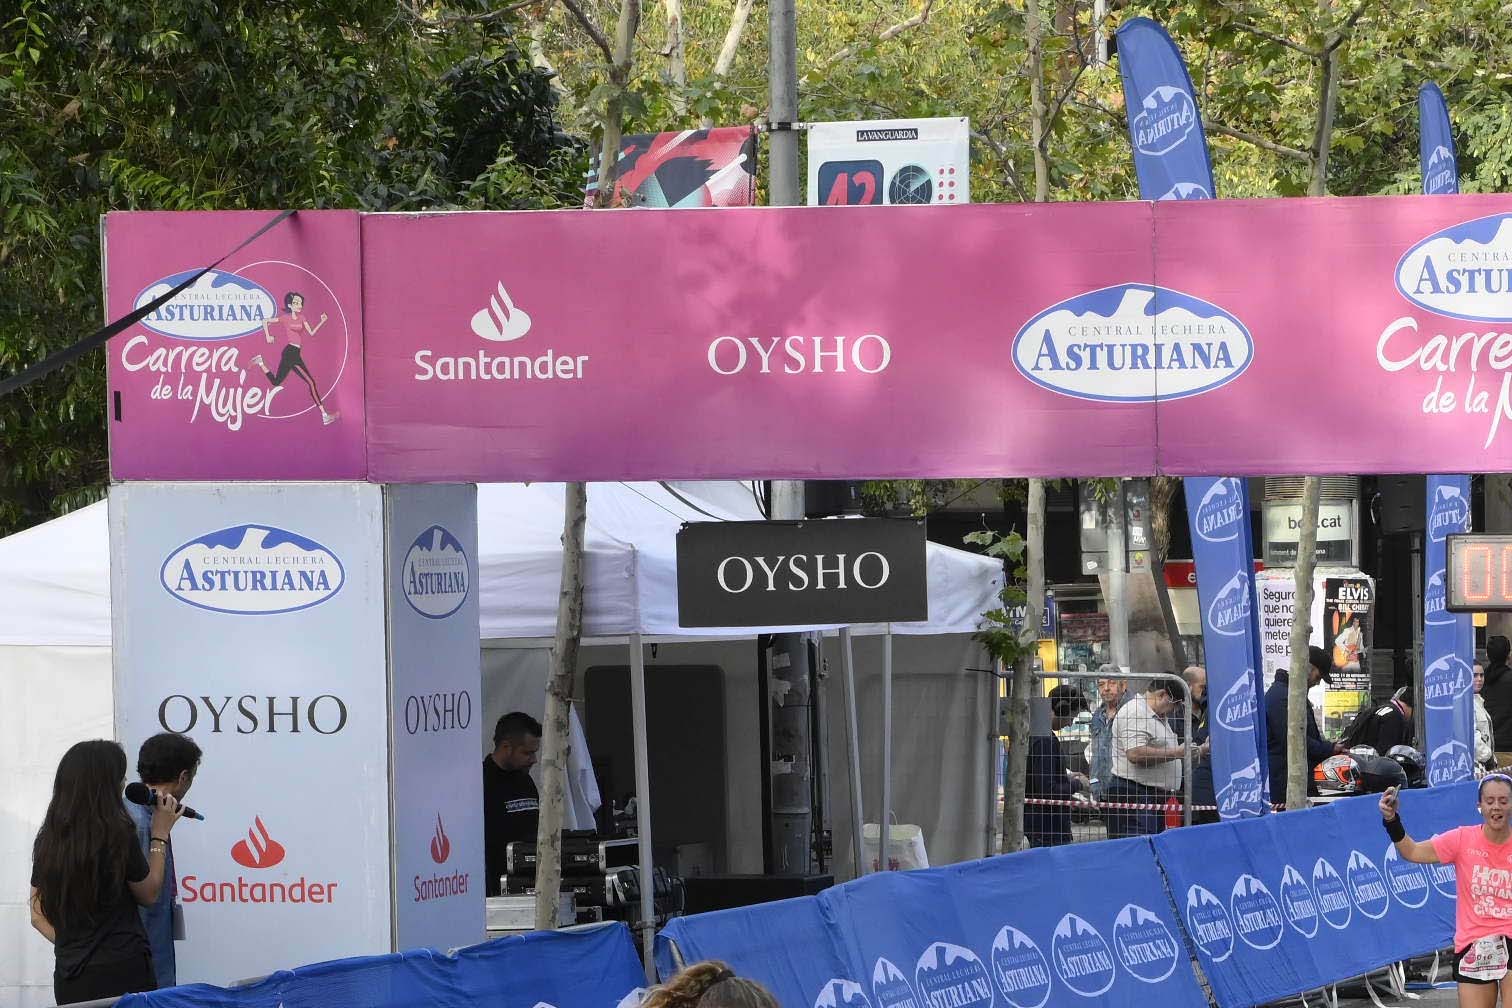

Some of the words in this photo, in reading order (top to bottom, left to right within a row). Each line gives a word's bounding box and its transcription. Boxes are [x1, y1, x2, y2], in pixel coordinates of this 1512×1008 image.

[147, 295, 265, 321] ASTURIANA
[1068, 324, 1143, 336] CENTRAL
[1150, 324, 1227, 336] LECHERA
[121, 335, 240, 372] Carrera
[414, 349, 589, 382] Santander
[707, 333, 892, 376] OYSHO
[1030, 328, 1235, 372] ASTURIANA
[150, 374, 173, 400] de
[177, 371, 193, 400] la
[190, 369, 284, 431] Mujer
[1422, 375, 1457, 414] de
[1464, 373, 1489, 414] la
[1288, 515, 1342, 530] b.cat
[175, 558, 331, 593] ASTURIANA
[203, 556, 261, 565] CENTRAL
[266, 556, 325, 565] LECHERA
[717, 551, 890, 594] OYSHO
[407, 561, 466, 596] ASTURIANA
[1338, 588, 1369, 600] ELVIS
[1264, 605, 1280, 616] que
[1265, 617, 1295, 631] quiere
[1265, 643, 1284, 654] este
[158, 694, 348, 736] OYSHO
[405, 690, 472, 735] OYSHO
[181, 875, 338, 905] Santander
[413, 870, 469, 902] Santander
[996, 960, 1049, 993] ASTURIANA
[1058, 947, 1113, 980] ASTURIANA
